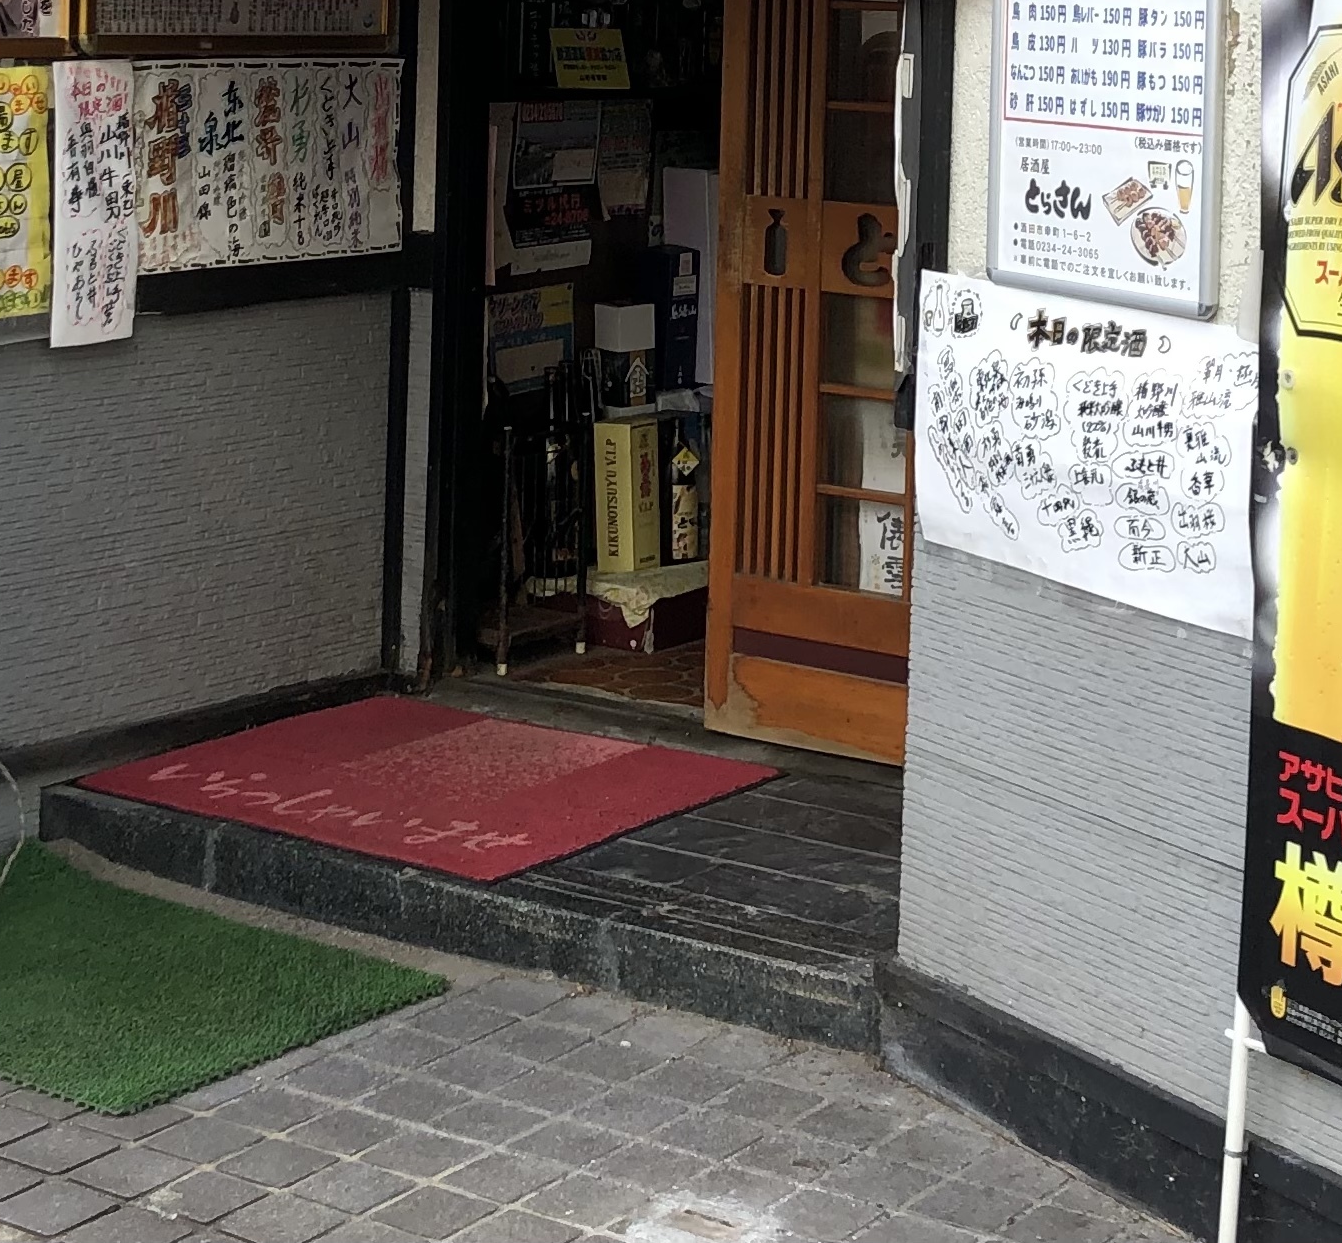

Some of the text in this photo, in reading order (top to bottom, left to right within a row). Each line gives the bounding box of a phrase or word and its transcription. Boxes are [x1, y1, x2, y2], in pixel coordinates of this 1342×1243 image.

[1040, 5, 1066, 23] 150円
[1103, 7, 1131, 26] 150円
[1138, 7, 1167, 26] 豚タン
[1174, 10, 1204, 30] 150円
[1138, 39, 1167, 59] 豚バラ
[1173, 43, 1204, 62] 150円
[1011, 63, 1035, 80] なんこつ
[1039, 66, 1065, 84] 150円
[1137, 71, 1165, 90] 豚もつ
[1172, 75, 1203, 95] 150円
[1316, 61, 1339, 95] ASAHI
[342, 73, 364, 150] 大山
[1038, 96, 1064, 115] 150円
[1101, 101, 1129, 120] 150円
[1171, 107, 1202, 127] 150円
[1020, 157, 1050, 175] 居酒屋
[1025, 178, 1092, 220] とらさん
[1026, 308, 1149, 358] 本日の限定酒
[606, 467, 620, 557] KIKUNOTSUYU
[146, 761, 533, 854] いらっしゃいませ
